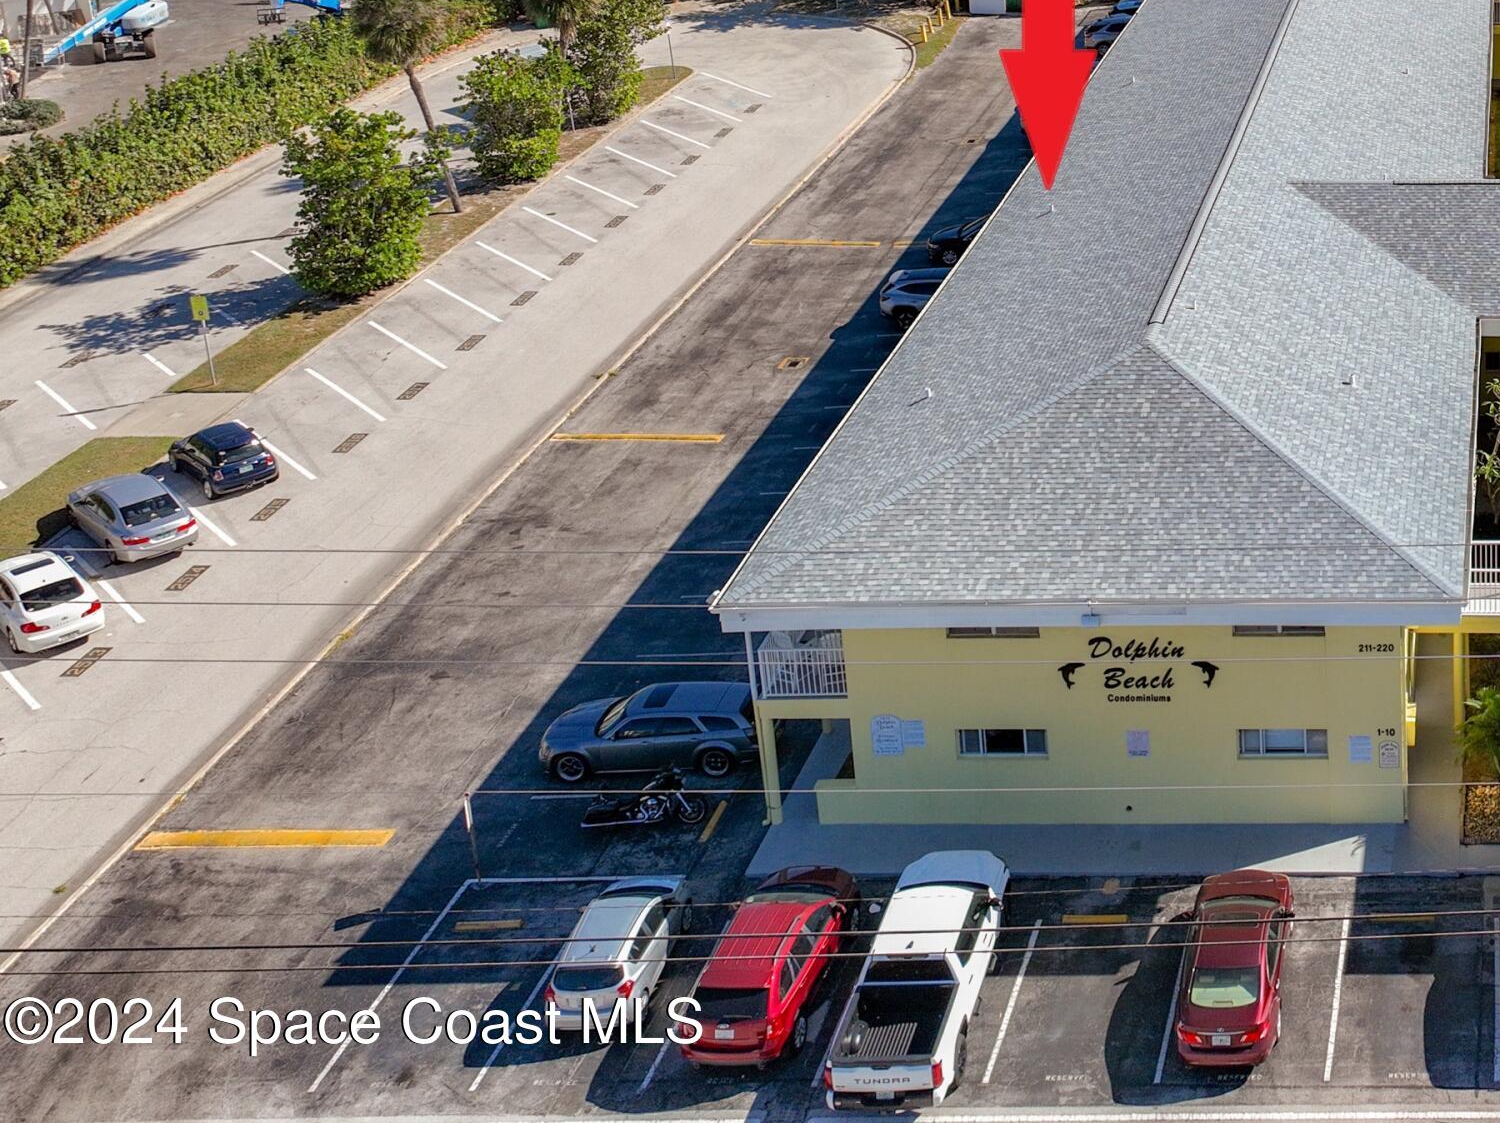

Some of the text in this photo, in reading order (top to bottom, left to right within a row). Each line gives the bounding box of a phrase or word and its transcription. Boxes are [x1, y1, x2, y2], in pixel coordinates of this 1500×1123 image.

[1088, 636, 1185, 664] Dolphin
[1358, 644, 1395, 652] 211-220
[62, 648, 110, 676] 2513
[1103, 667, 1175, 689] Beach
[1107, 694, 1171, 702] Condominiums
[1377, 728, 1396, 737] 1-10
[853, 1077, 911, 1085] TUNDRA
